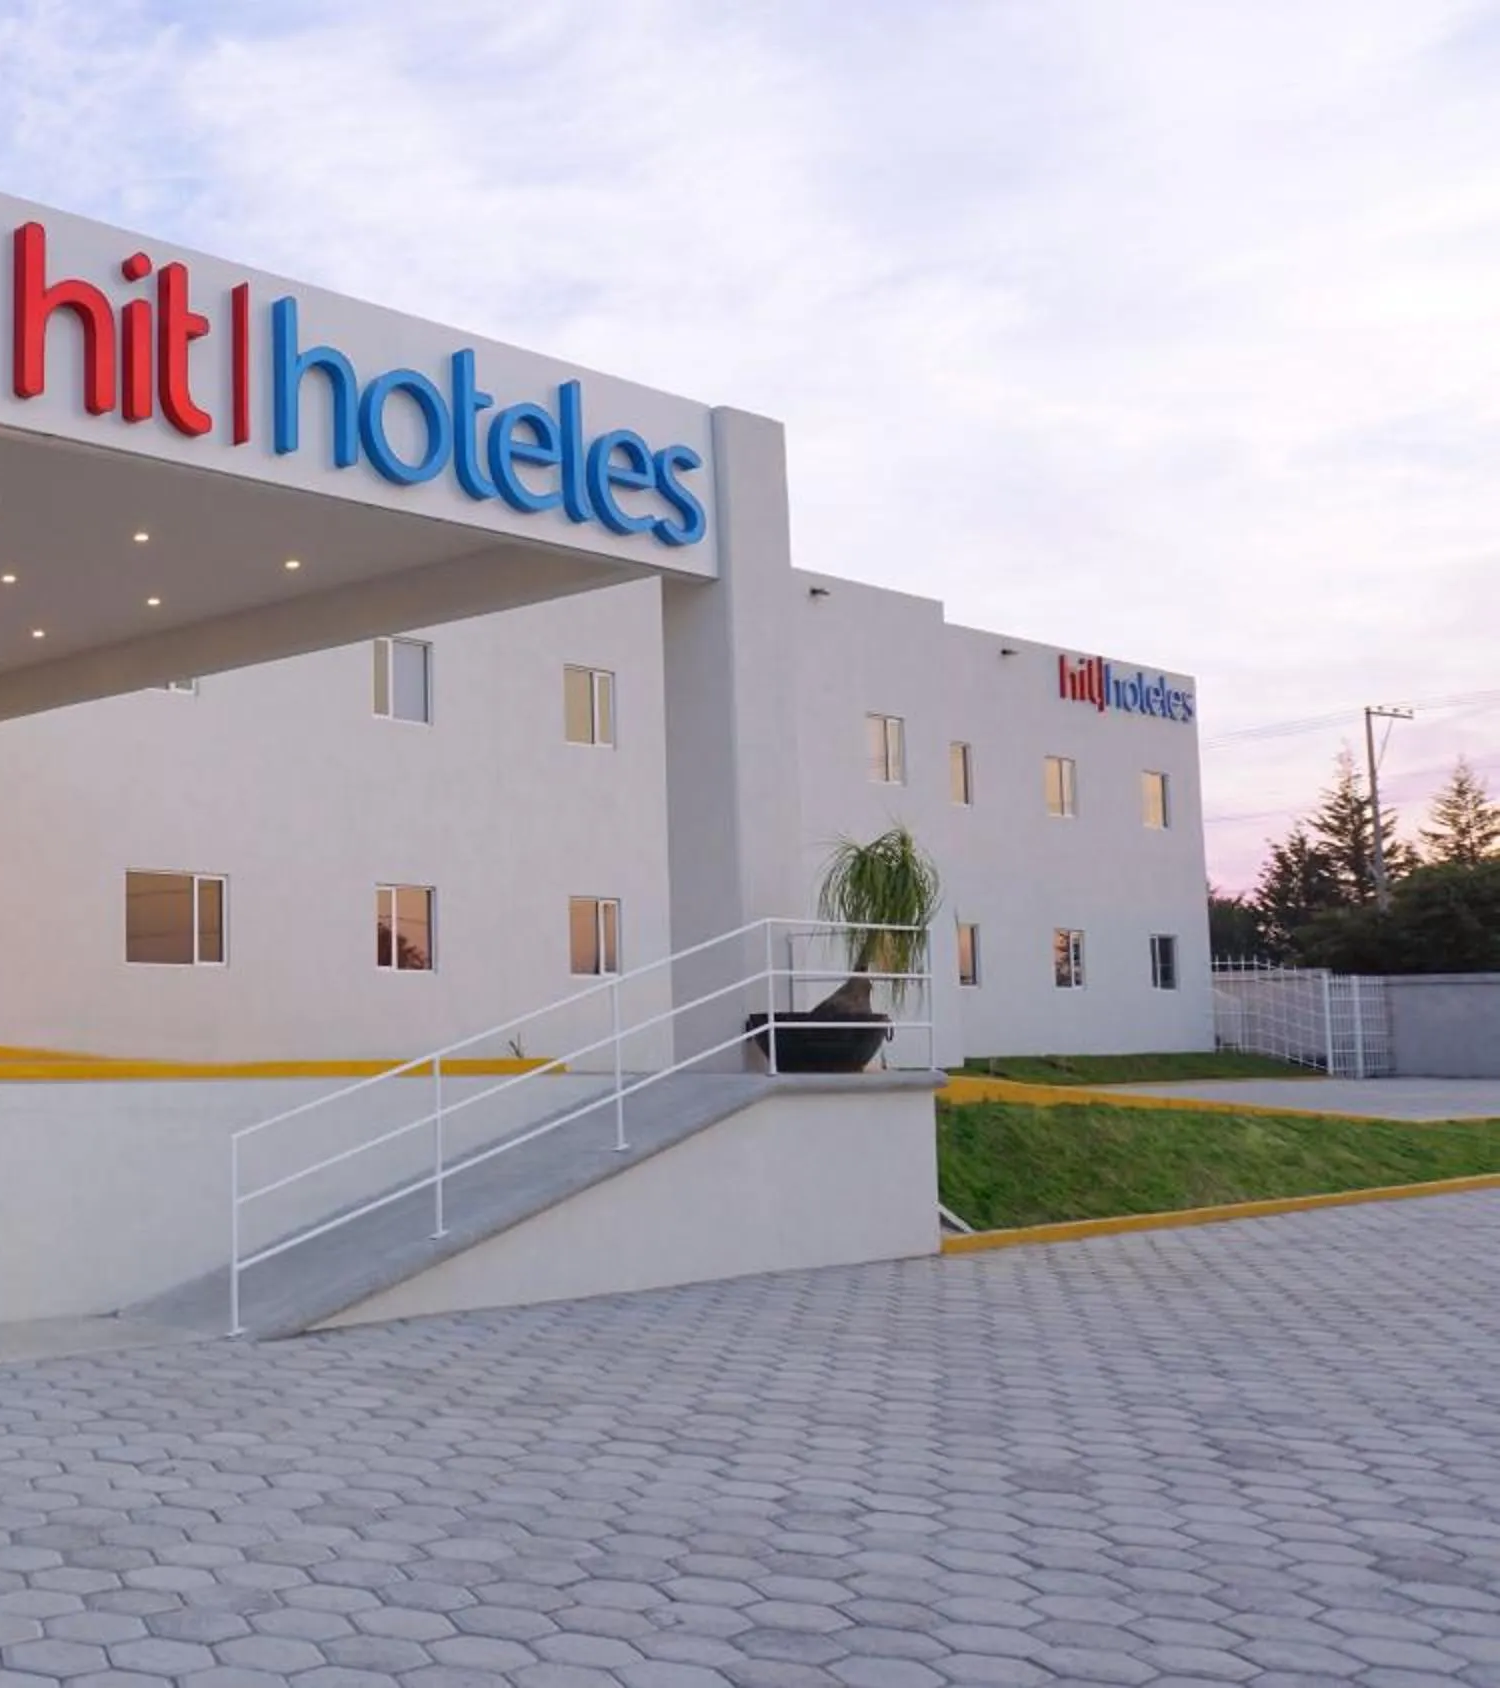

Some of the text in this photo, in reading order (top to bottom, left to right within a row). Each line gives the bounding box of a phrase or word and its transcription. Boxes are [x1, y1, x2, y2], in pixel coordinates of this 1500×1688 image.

[13, 221, 707, 546] hit hoteles
[1104, 663, 1194, 723] hoteles
